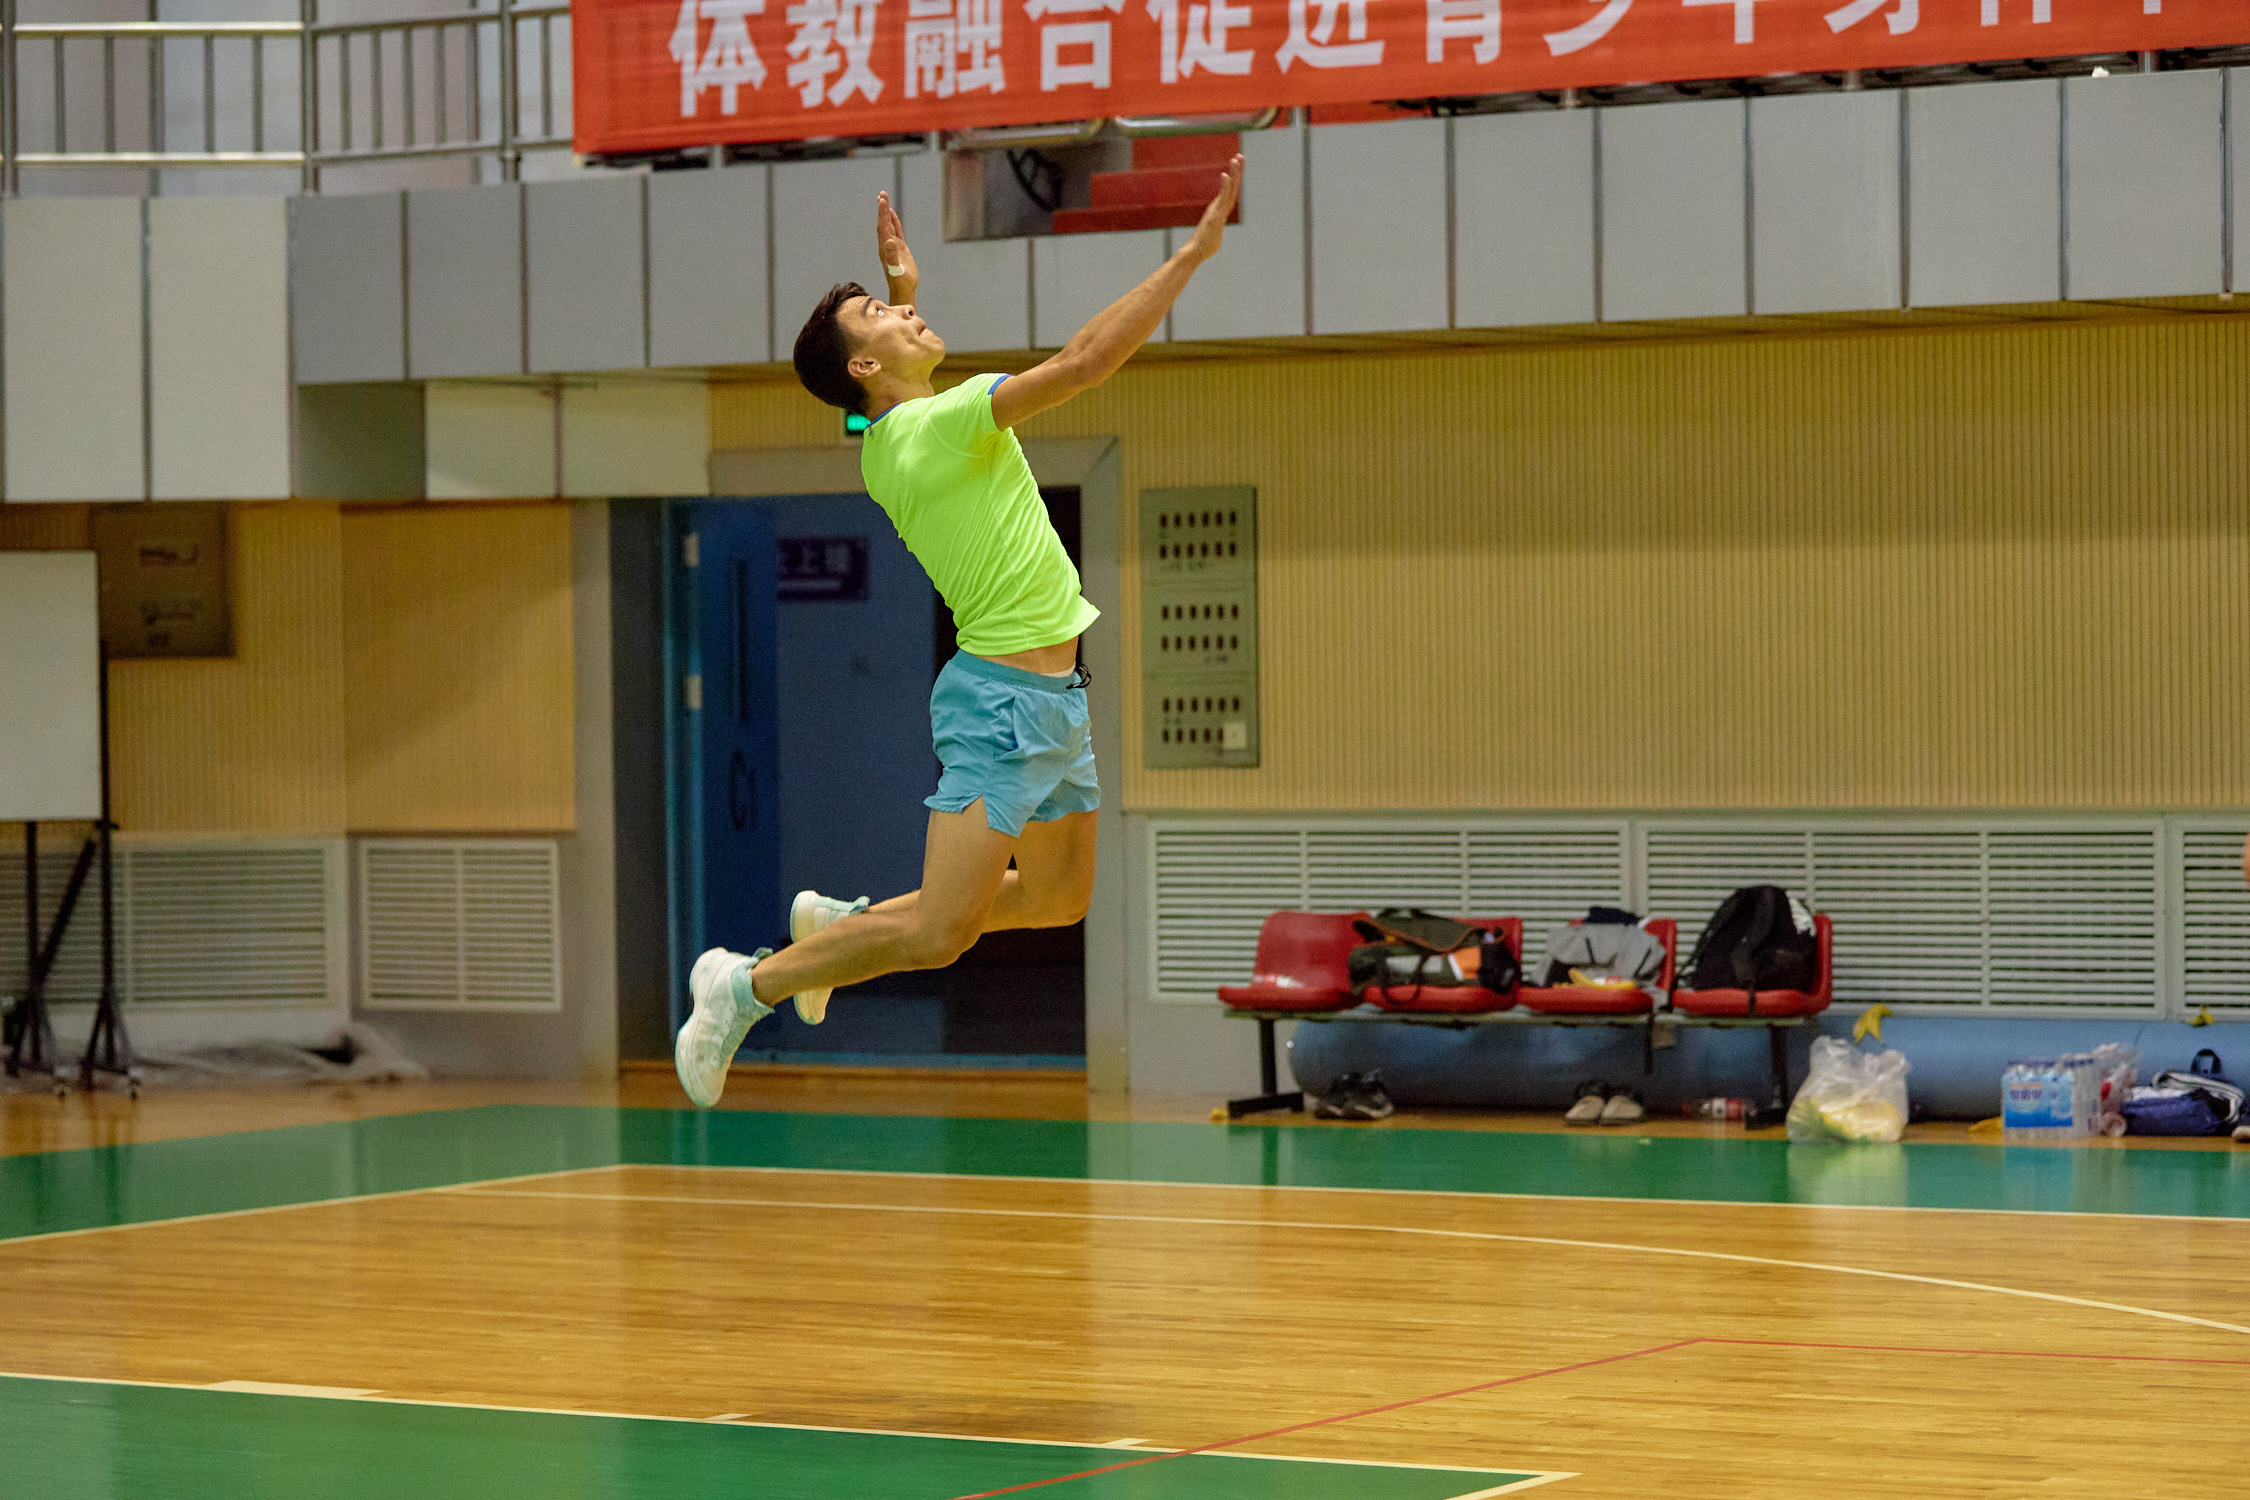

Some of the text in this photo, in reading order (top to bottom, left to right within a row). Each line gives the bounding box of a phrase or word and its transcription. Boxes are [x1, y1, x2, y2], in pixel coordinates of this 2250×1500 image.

[669, 0, 2162, 117] 体教融合促进
